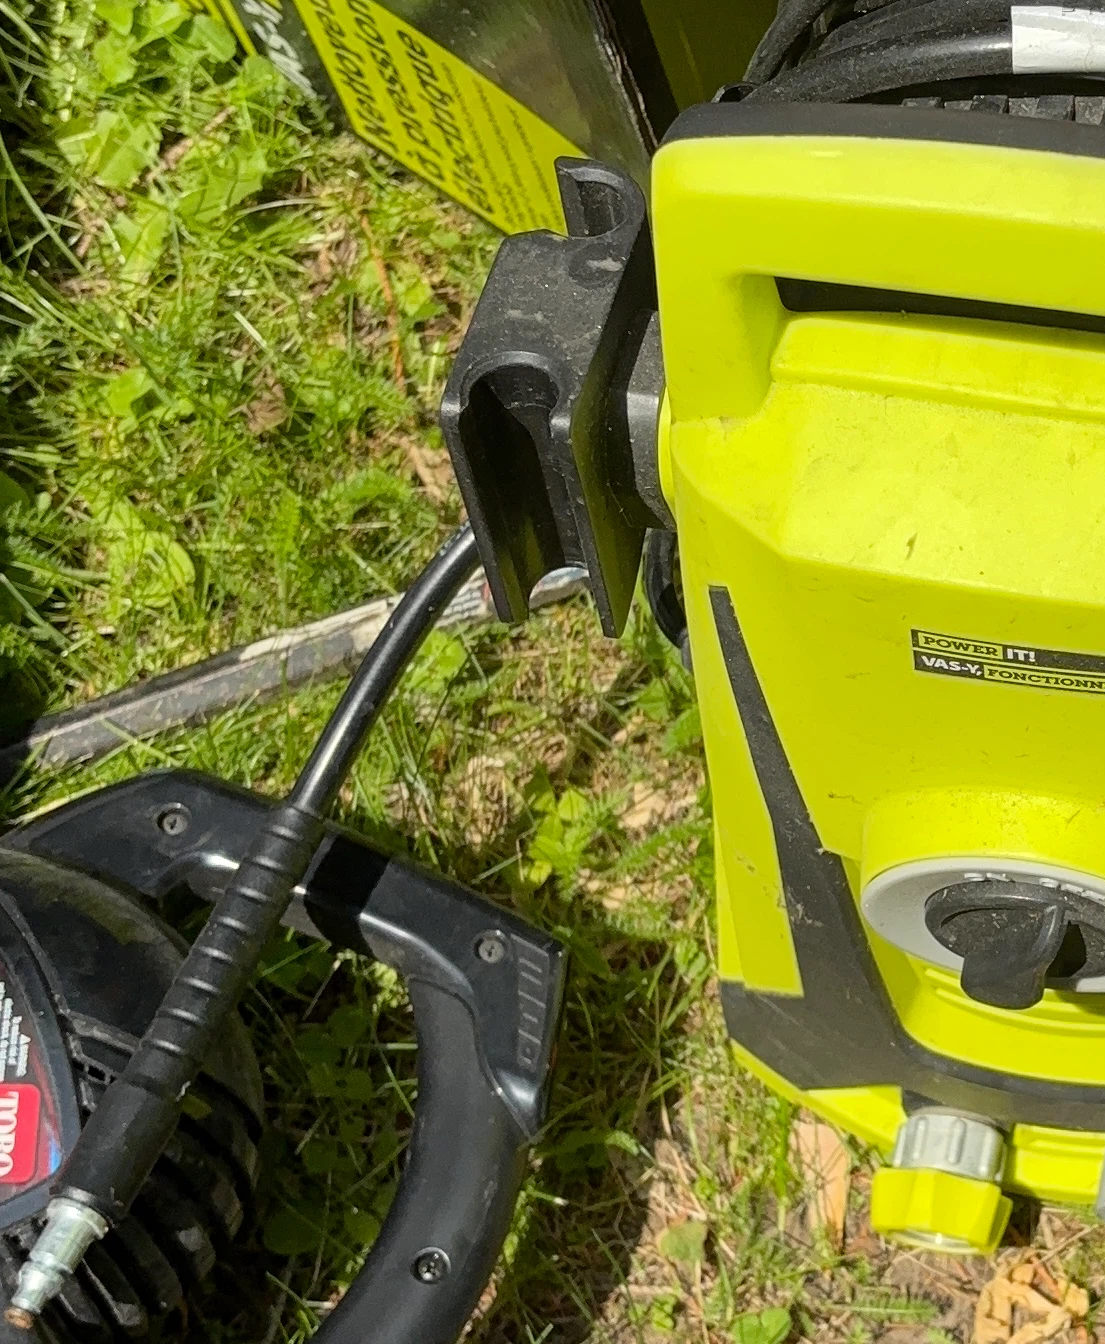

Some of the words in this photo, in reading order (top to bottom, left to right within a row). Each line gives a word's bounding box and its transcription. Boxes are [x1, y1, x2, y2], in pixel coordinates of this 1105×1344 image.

[922, 635, 999, 658] POWER
[1005, 646, 1037, 664] IT!
[920, 654, 984, 677] VAS-Y,
